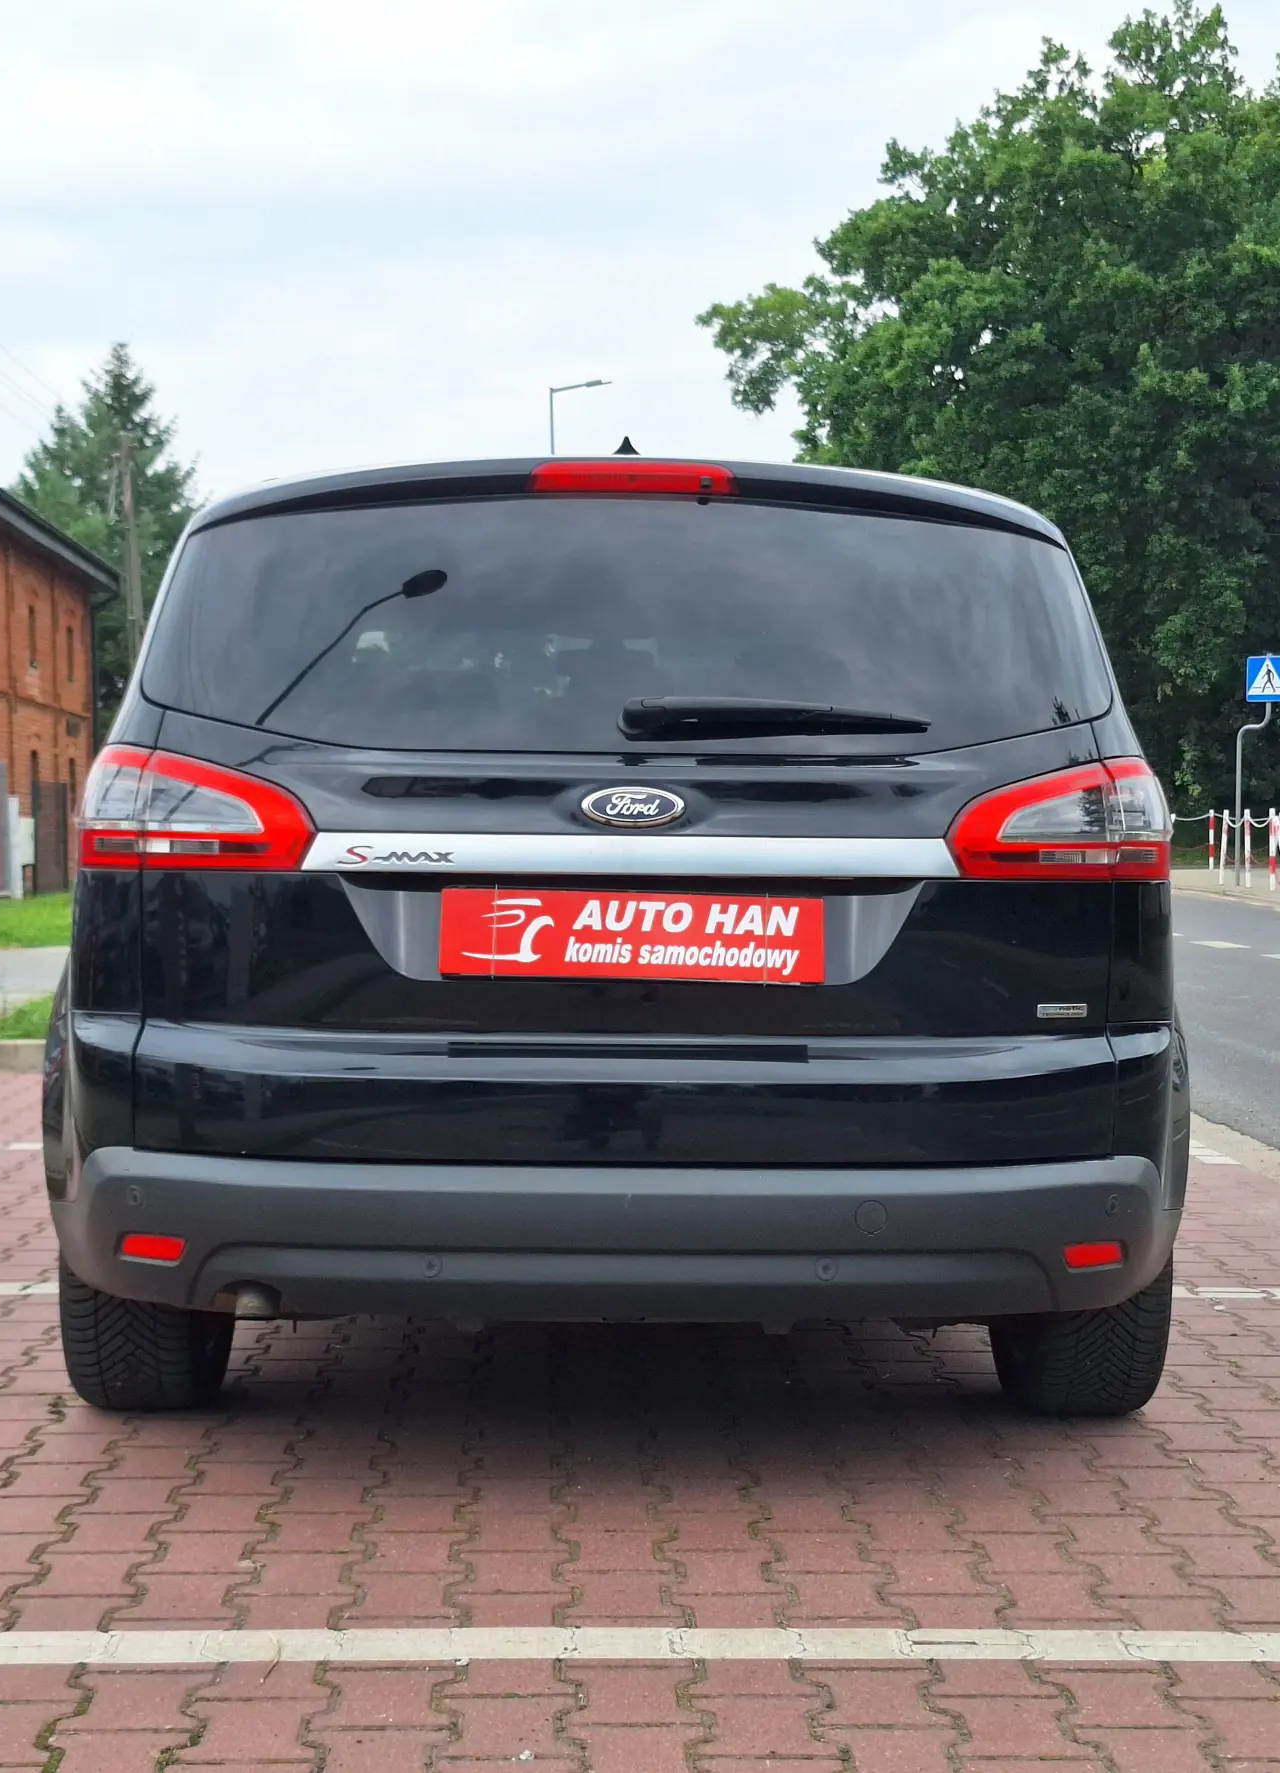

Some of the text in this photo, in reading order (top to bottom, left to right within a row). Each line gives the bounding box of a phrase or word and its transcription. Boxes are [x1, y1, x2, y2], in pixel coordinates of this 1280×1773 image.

[605, 792, 660, 818] Ford
[336, 845, 456, 865] S-MAX
[572, 899, 799, 938] AUTO HAN
[565, 936, 799, 975] komis samochodowy
